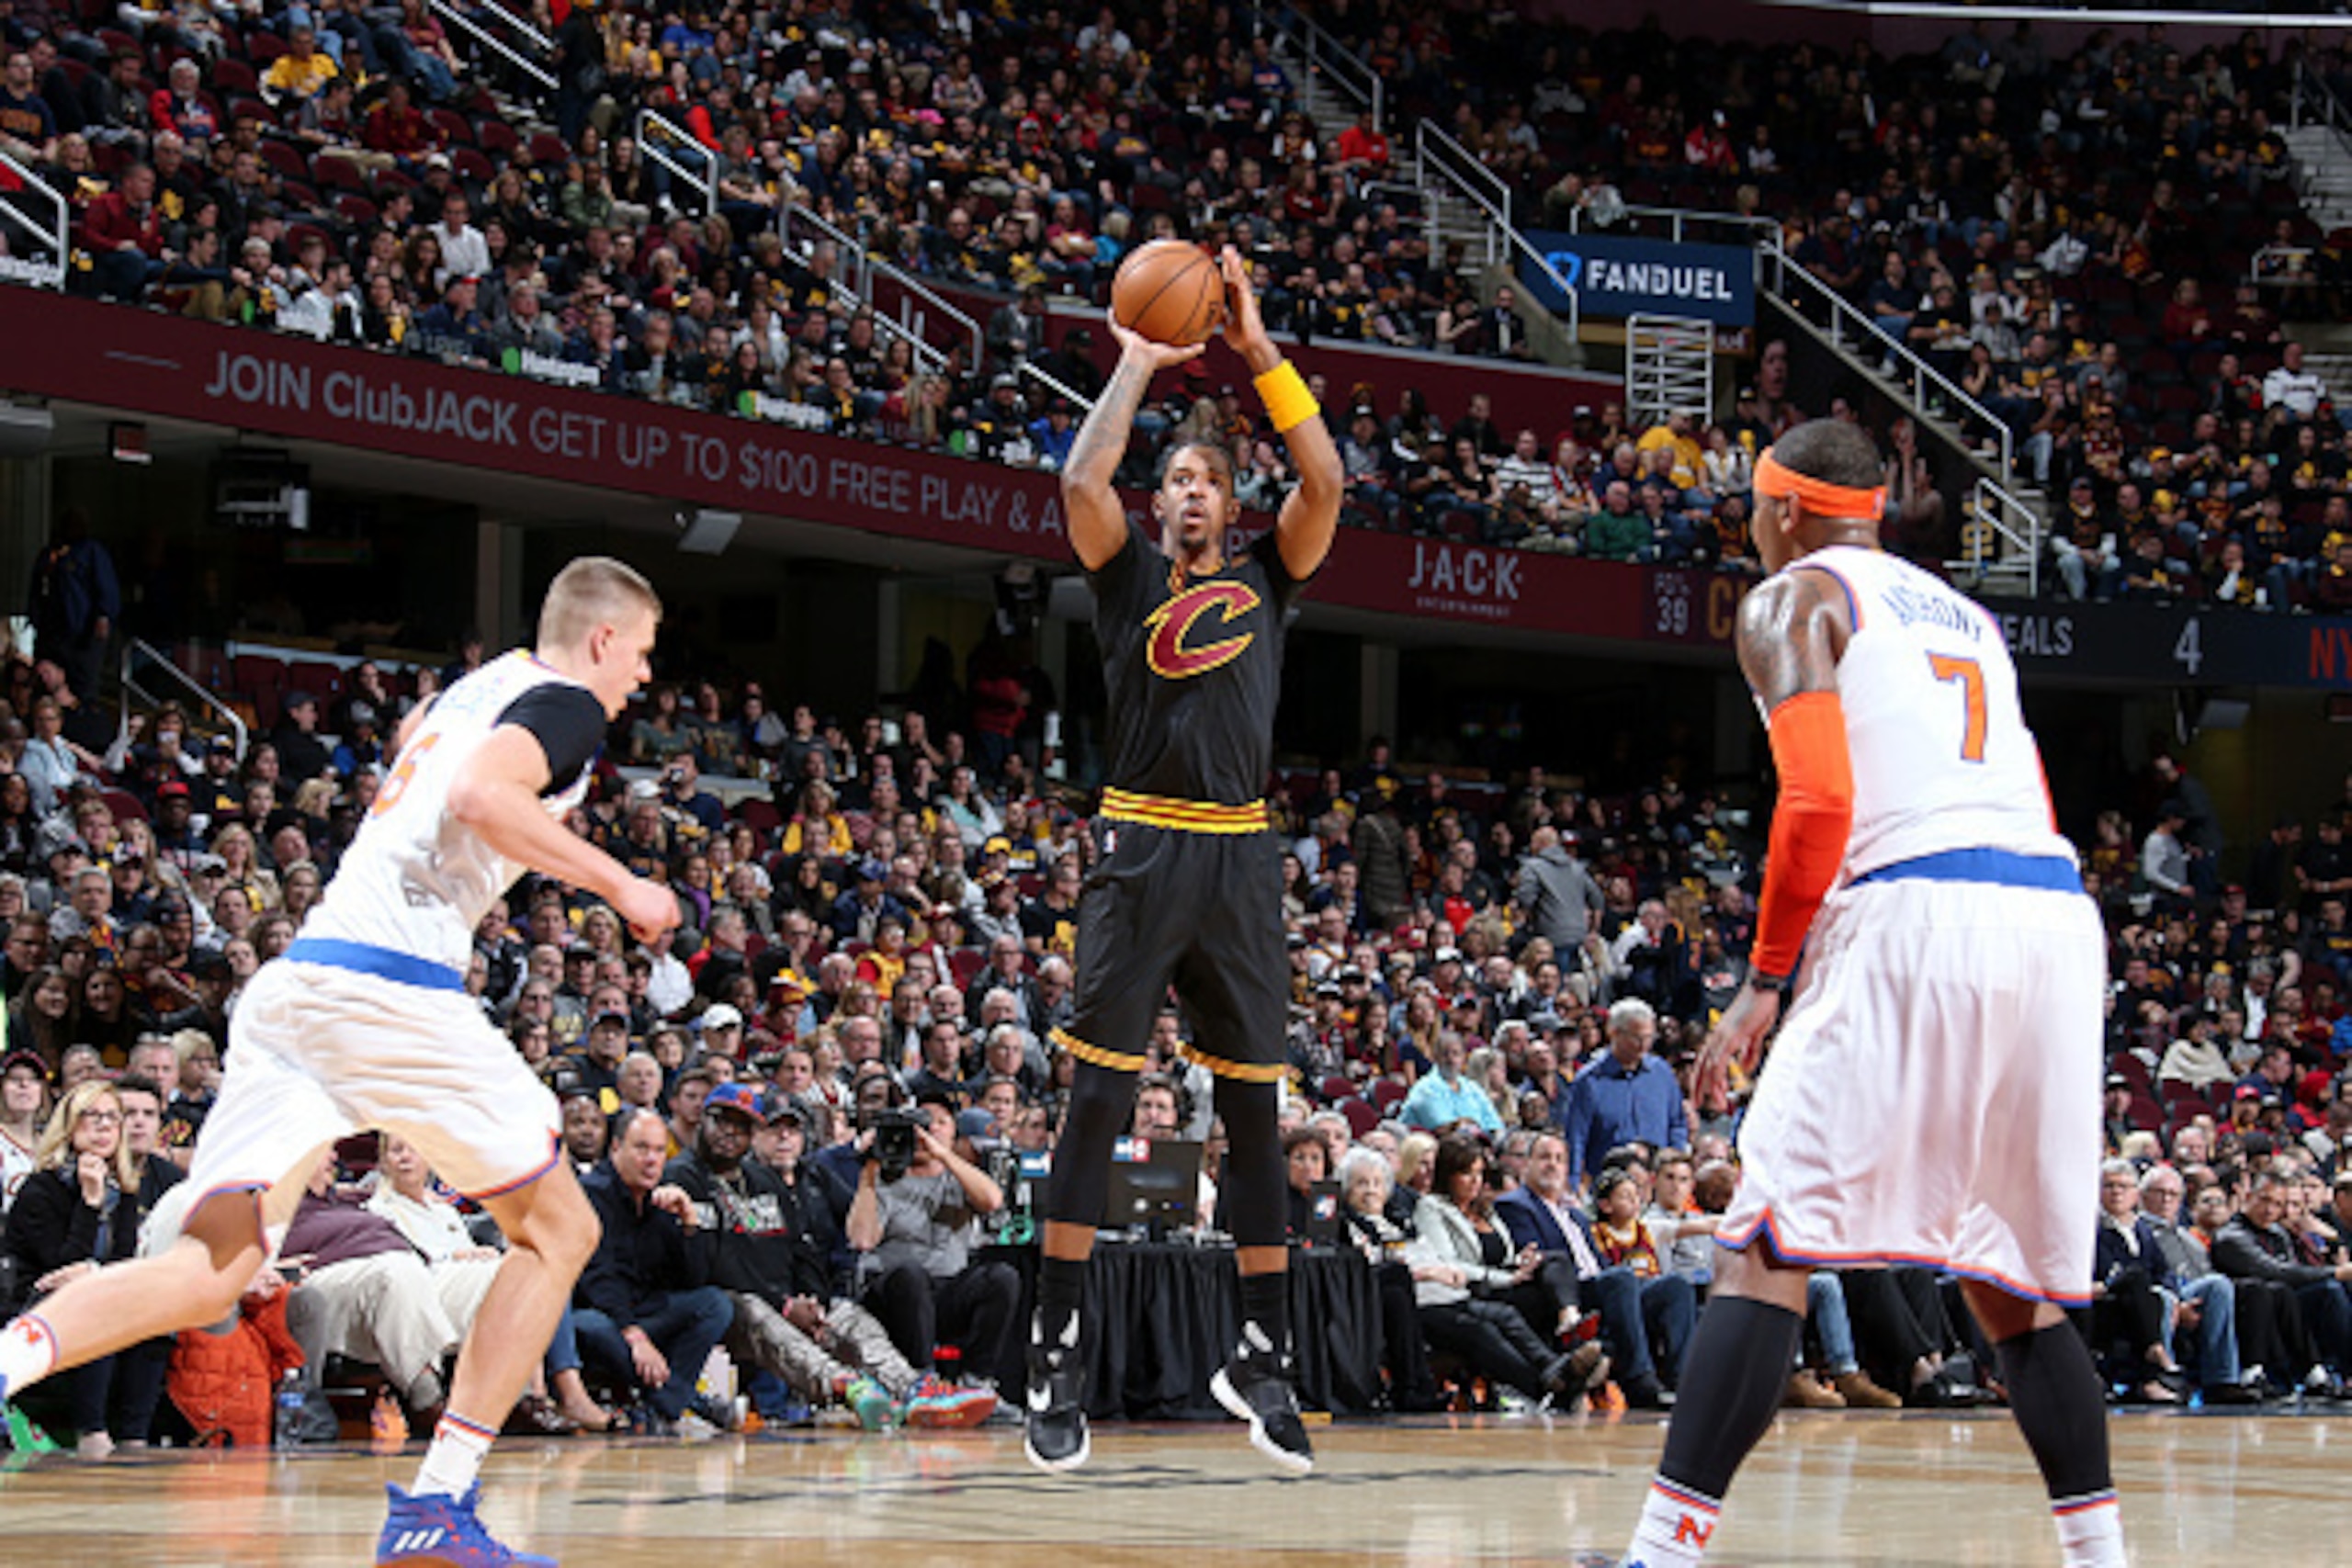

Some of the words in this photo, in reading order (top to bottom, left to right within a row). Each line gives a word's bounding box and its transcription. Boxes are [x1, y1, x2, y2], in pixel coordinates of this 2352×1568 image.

[1587, 260, 1733, 300] FANDUEL
[205, 351, 311, 410] JOIN
[323, 372, 517, 445] ClubJACK
[529, 407, 606, 457] GET
[616, 423, 669, 468] UP
[680, 432, 729, 480] TO
[739, 441, 818, 497] $100
[829, 459, 910, 512] FREE
[921, 474, 1001, 526] PLAY
[1008, 490, 1031, 532] &
[1657, 596, 1690, 636] 39
[2000, 615, 2075, 656] EALS
[2174, 617, 2202, 675] 4
[1925, 649, 1987, 764] 7
[371, 732, 441, 819] 6
